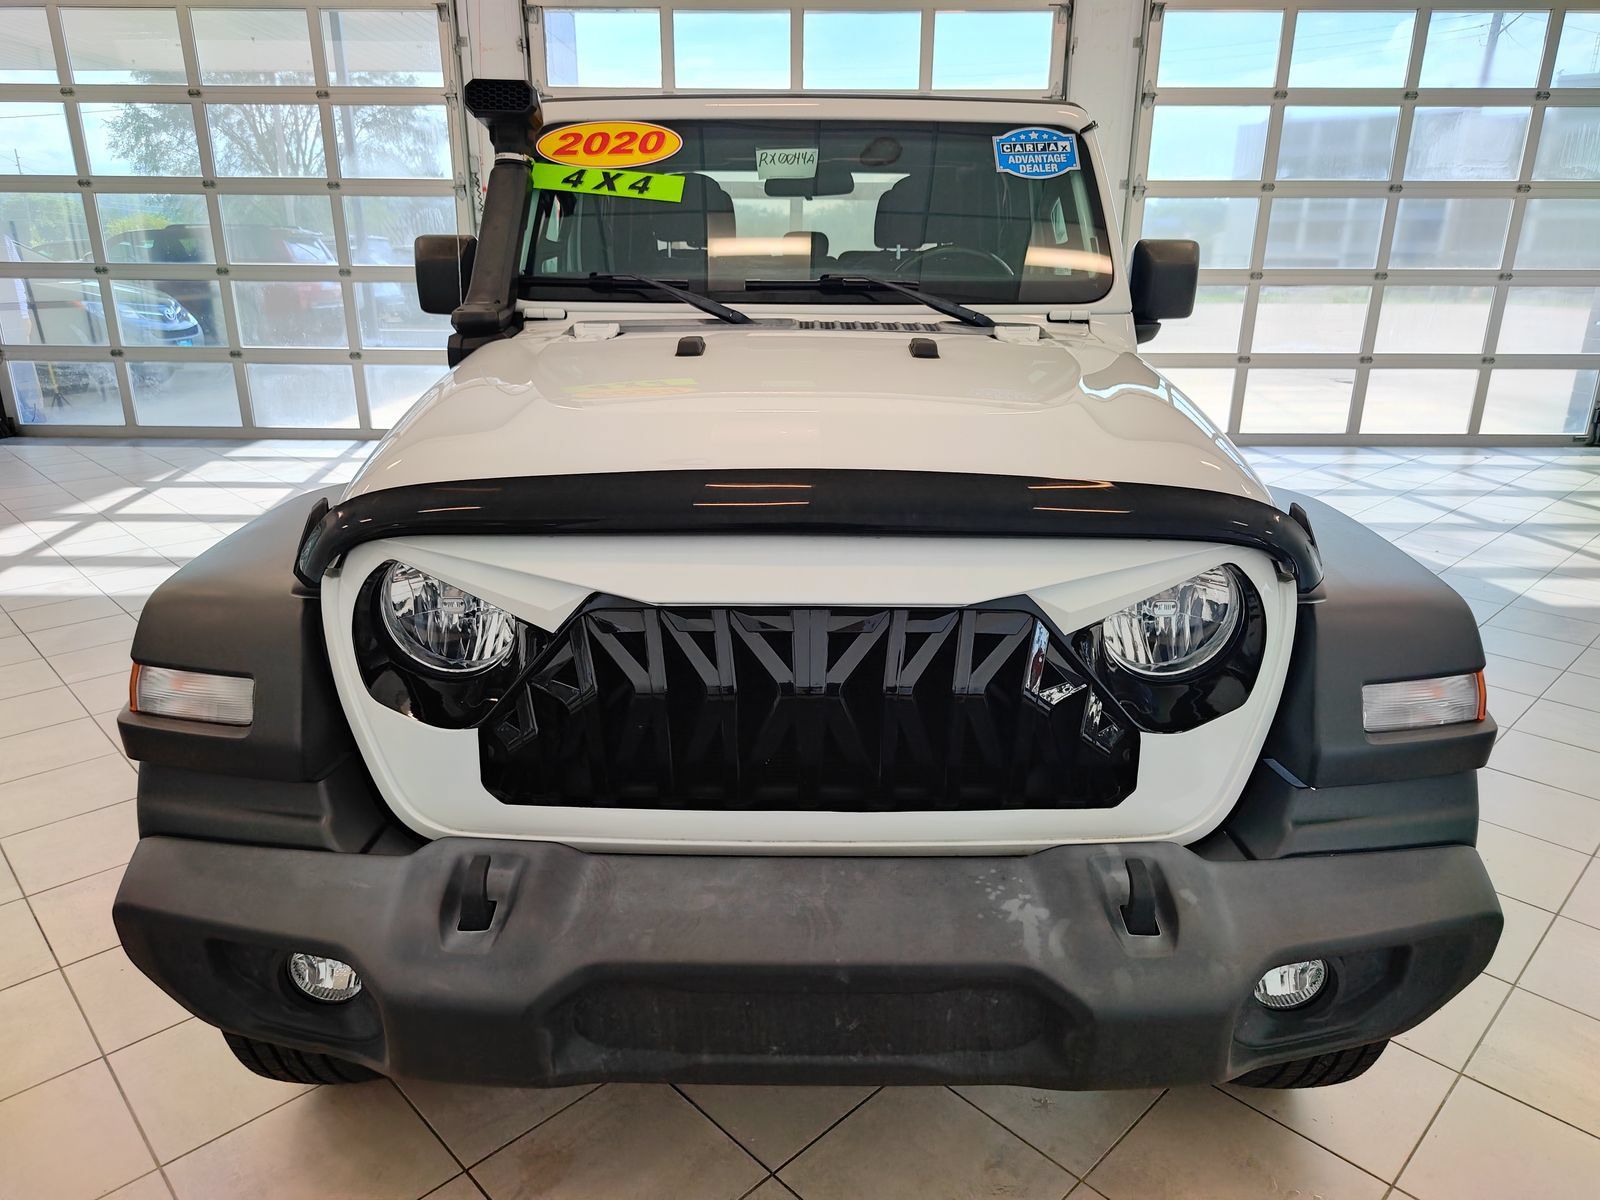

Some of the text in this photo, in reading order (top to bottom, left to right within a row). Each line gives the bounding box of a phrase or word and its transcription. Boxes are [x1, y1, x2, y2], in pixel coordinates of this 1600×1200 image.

[552, 130, 666, 157] 2020
[1001, 142, 1070, 153] CARFAX
[1008, 154, 1067, 164] ADVANTAGE
[1020, 163, 1058, 173] DEALER
